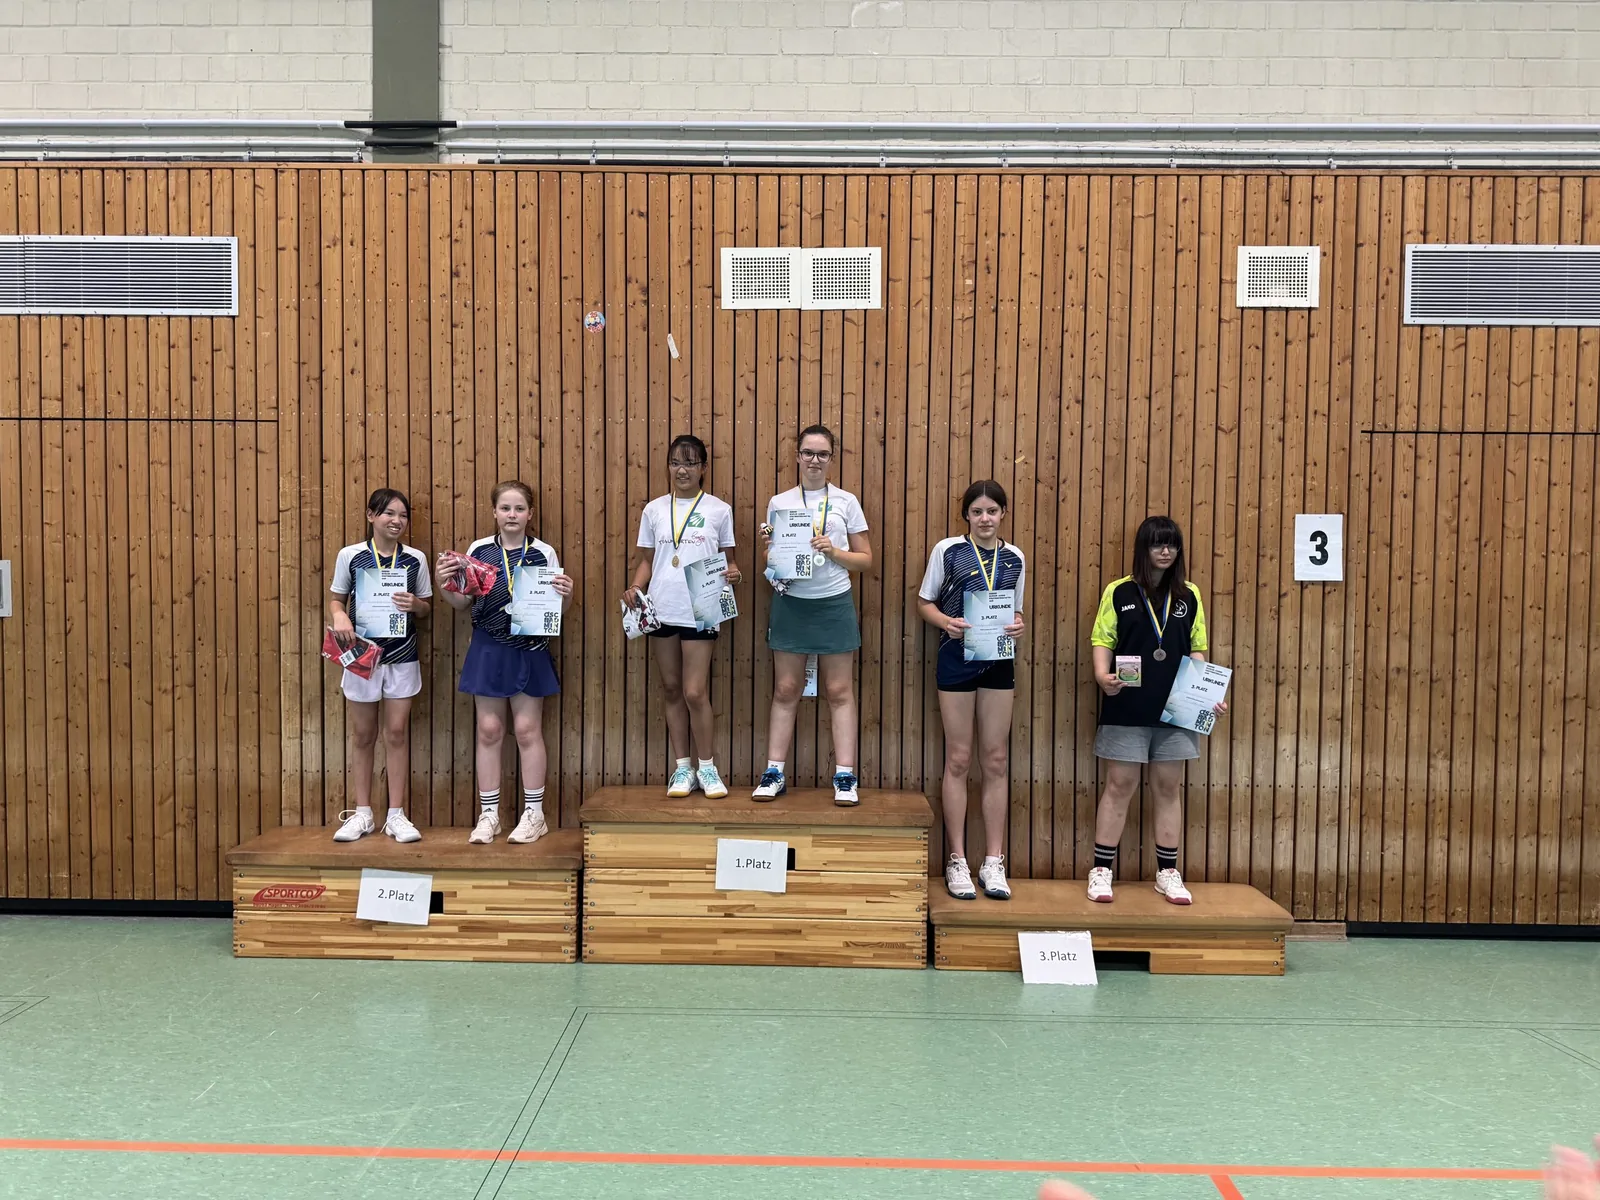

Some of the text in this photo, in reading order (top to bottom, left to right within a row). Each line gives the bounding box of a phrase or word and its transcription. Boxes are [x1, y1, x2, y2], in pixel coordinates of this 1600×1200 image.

[1308, 530, 1329, 566] 3
[706, 565, 726, 576] URKUNDE
[1121, 603, 1136, 612] JAKO
[1202, 676, 1226, 687] URKUNDE
[1195, 685, 1209, 693] PLATZ
[735, 858, 772, 870] 1.Platz
[264, 888, 314, 899] SPORTCO
[377, 888, 415, 902] 2.Platz
[1039, 950, 1078, 962] 3.Platz
